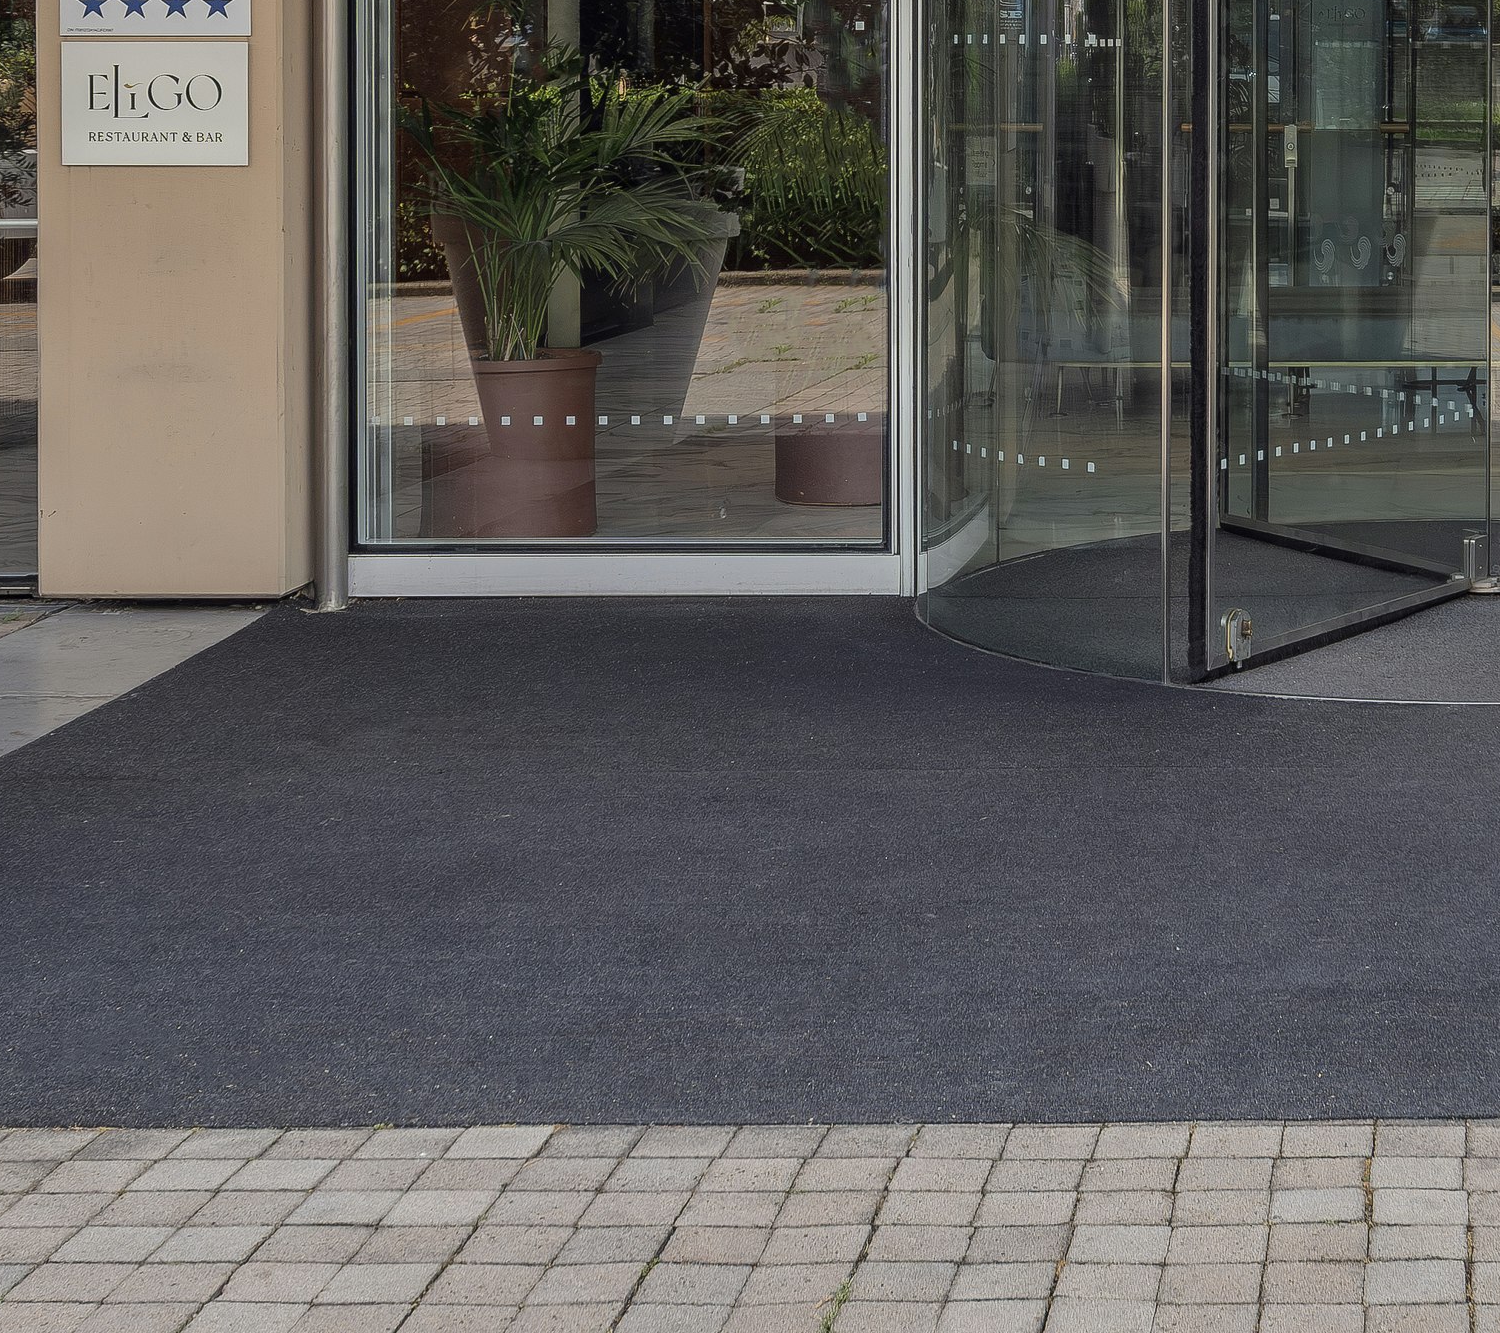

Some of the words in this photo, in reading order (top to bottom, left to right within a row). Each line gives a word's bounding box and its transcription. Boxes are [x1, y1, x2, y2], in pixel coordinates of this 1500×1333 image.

[88, 131, 178, 143] RESTAURANT
[181, 131, 193, 143] &
[196, 131, 223, 143] BAR
